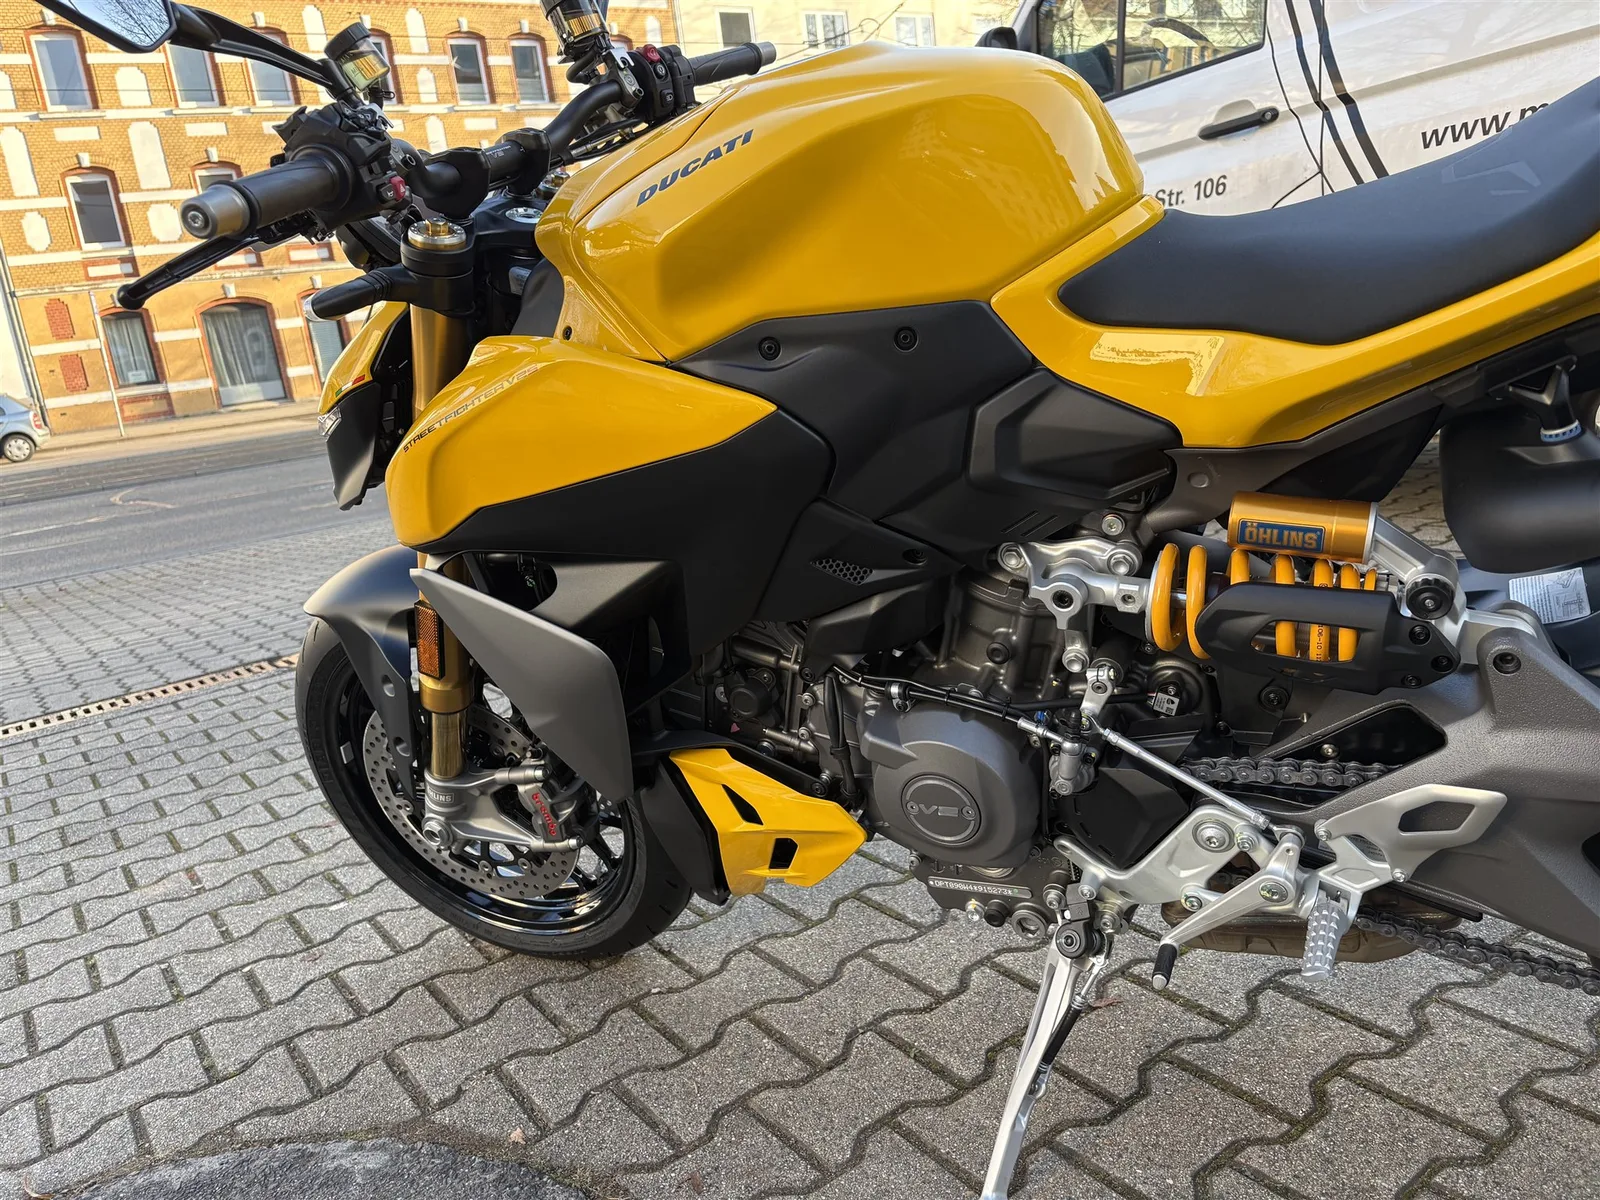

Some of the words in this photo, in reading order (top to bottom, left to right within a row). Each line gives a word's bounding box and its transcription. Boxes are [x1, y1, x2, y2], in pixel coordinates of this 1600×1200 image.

[1421, 103, 1549, 150] wwwm
[636, 129, 753, 207] DUCATI
[1155, 189, 1185, 207] Str.
[1194, 174, 1227, 201] 106
[1244, 522, 1318, 549] ÖHLINS
[532, 792, 557, 836] brembo
